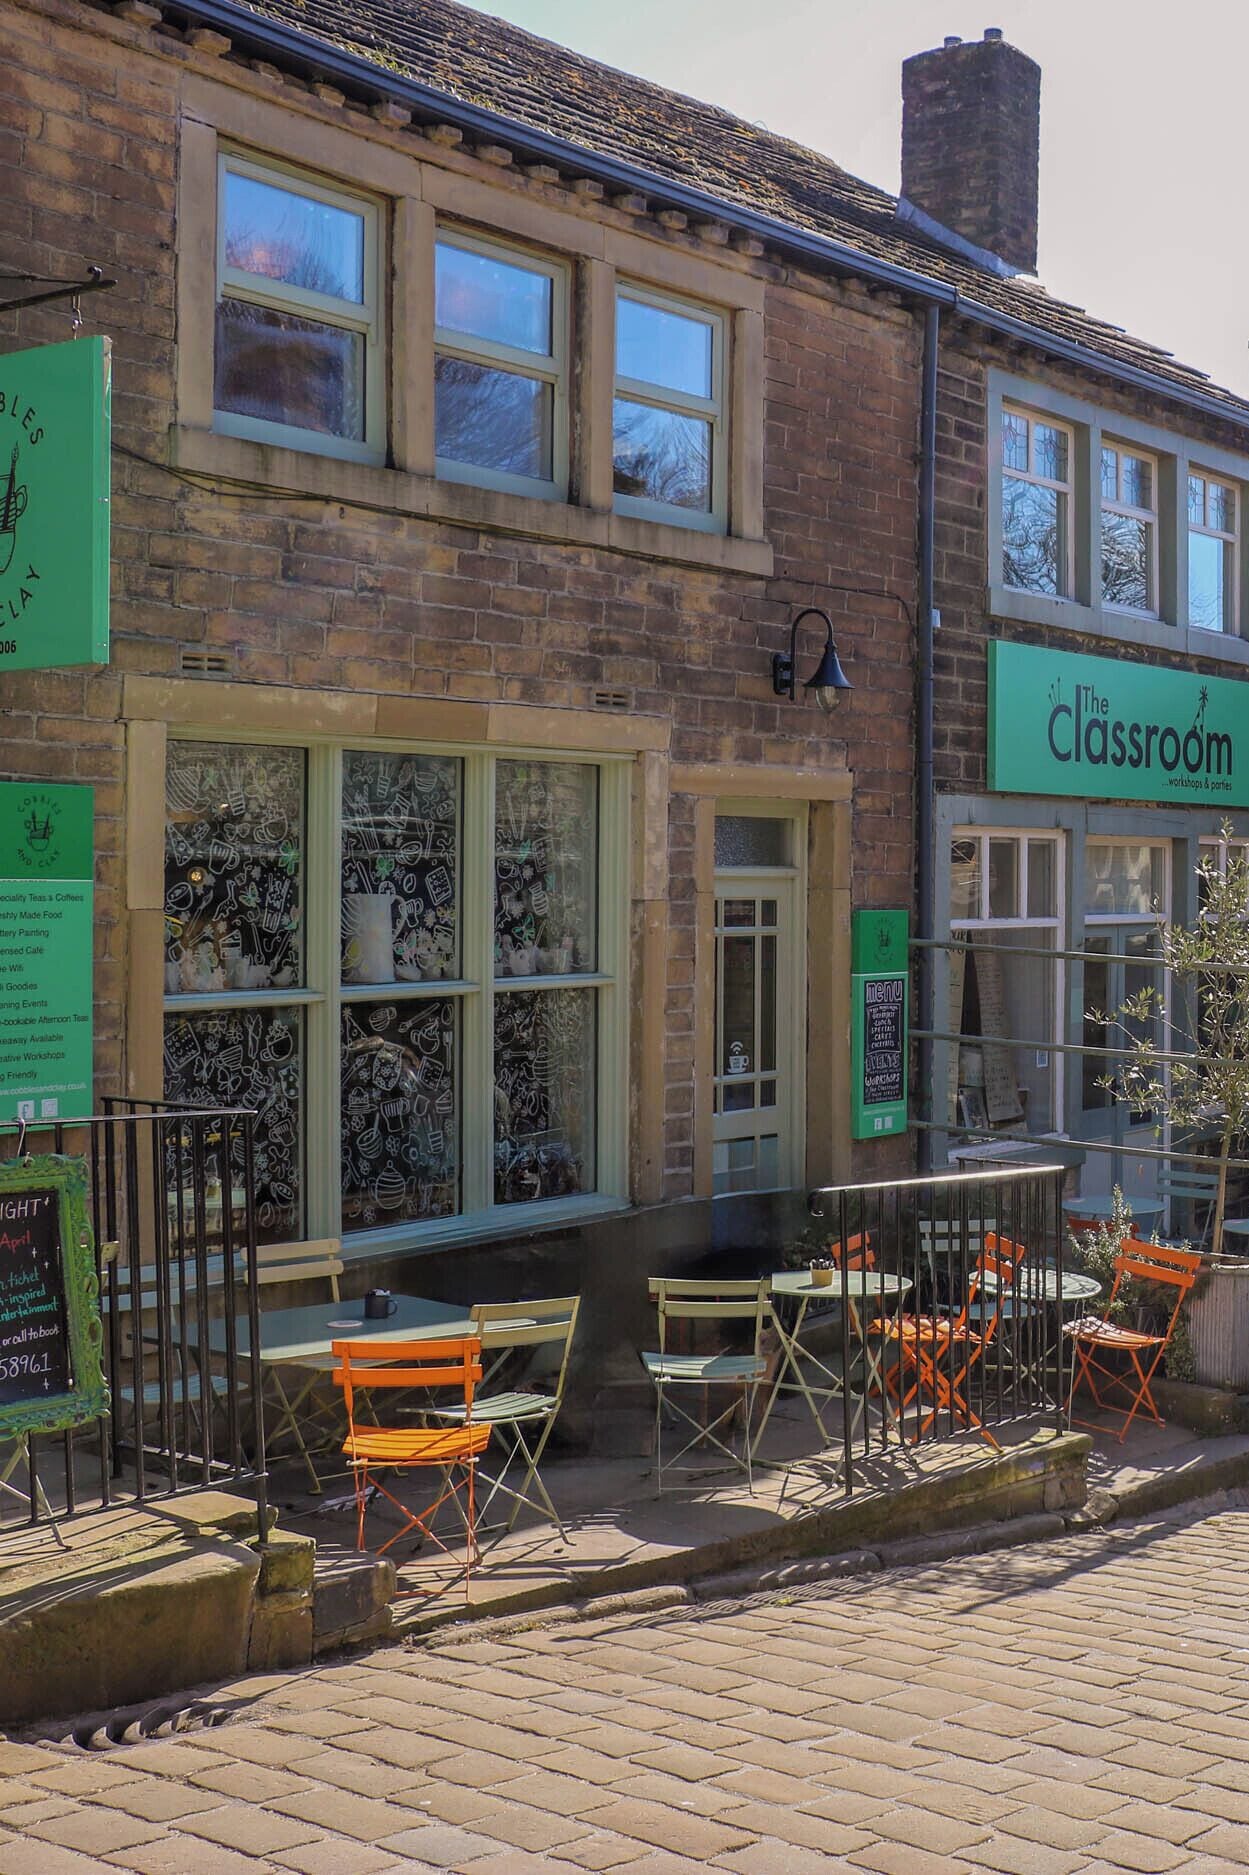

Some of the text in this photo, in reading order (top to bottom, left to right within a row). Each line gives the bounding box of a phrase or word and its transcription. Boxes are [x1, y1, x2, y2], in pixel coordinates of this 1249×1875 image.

[1083, 686, 1109, 715] The
[1048, 684, 1232, 775] Classroom
[1204, 777, 1210, 789] &
[1211, 780, 1232, 792] parties
[28, 893, 48, 902] Teas
[55, 893, 84, 902] Coffees
[20, 910, 41, 919] Made
[43, 910, 63, 919] Food
[19, 928, 49, 938] Painting
[6, 982, 38, 992] Goodies
[866, 981, 902, 1003] menu
[22, 999, 48, 1008] Events
[39, 1015, 71, 1024] Afternoon
[74, 1014, 88, 1022] Teas
[31, 1034, 64, 1042] Available
[24, 1051, 65, 1061] Workshops
[8, 1070, 37, 1079] Friendly
[0, 1229, 31, 1254] April
[2, 1323, 60, 1346] or call to book
